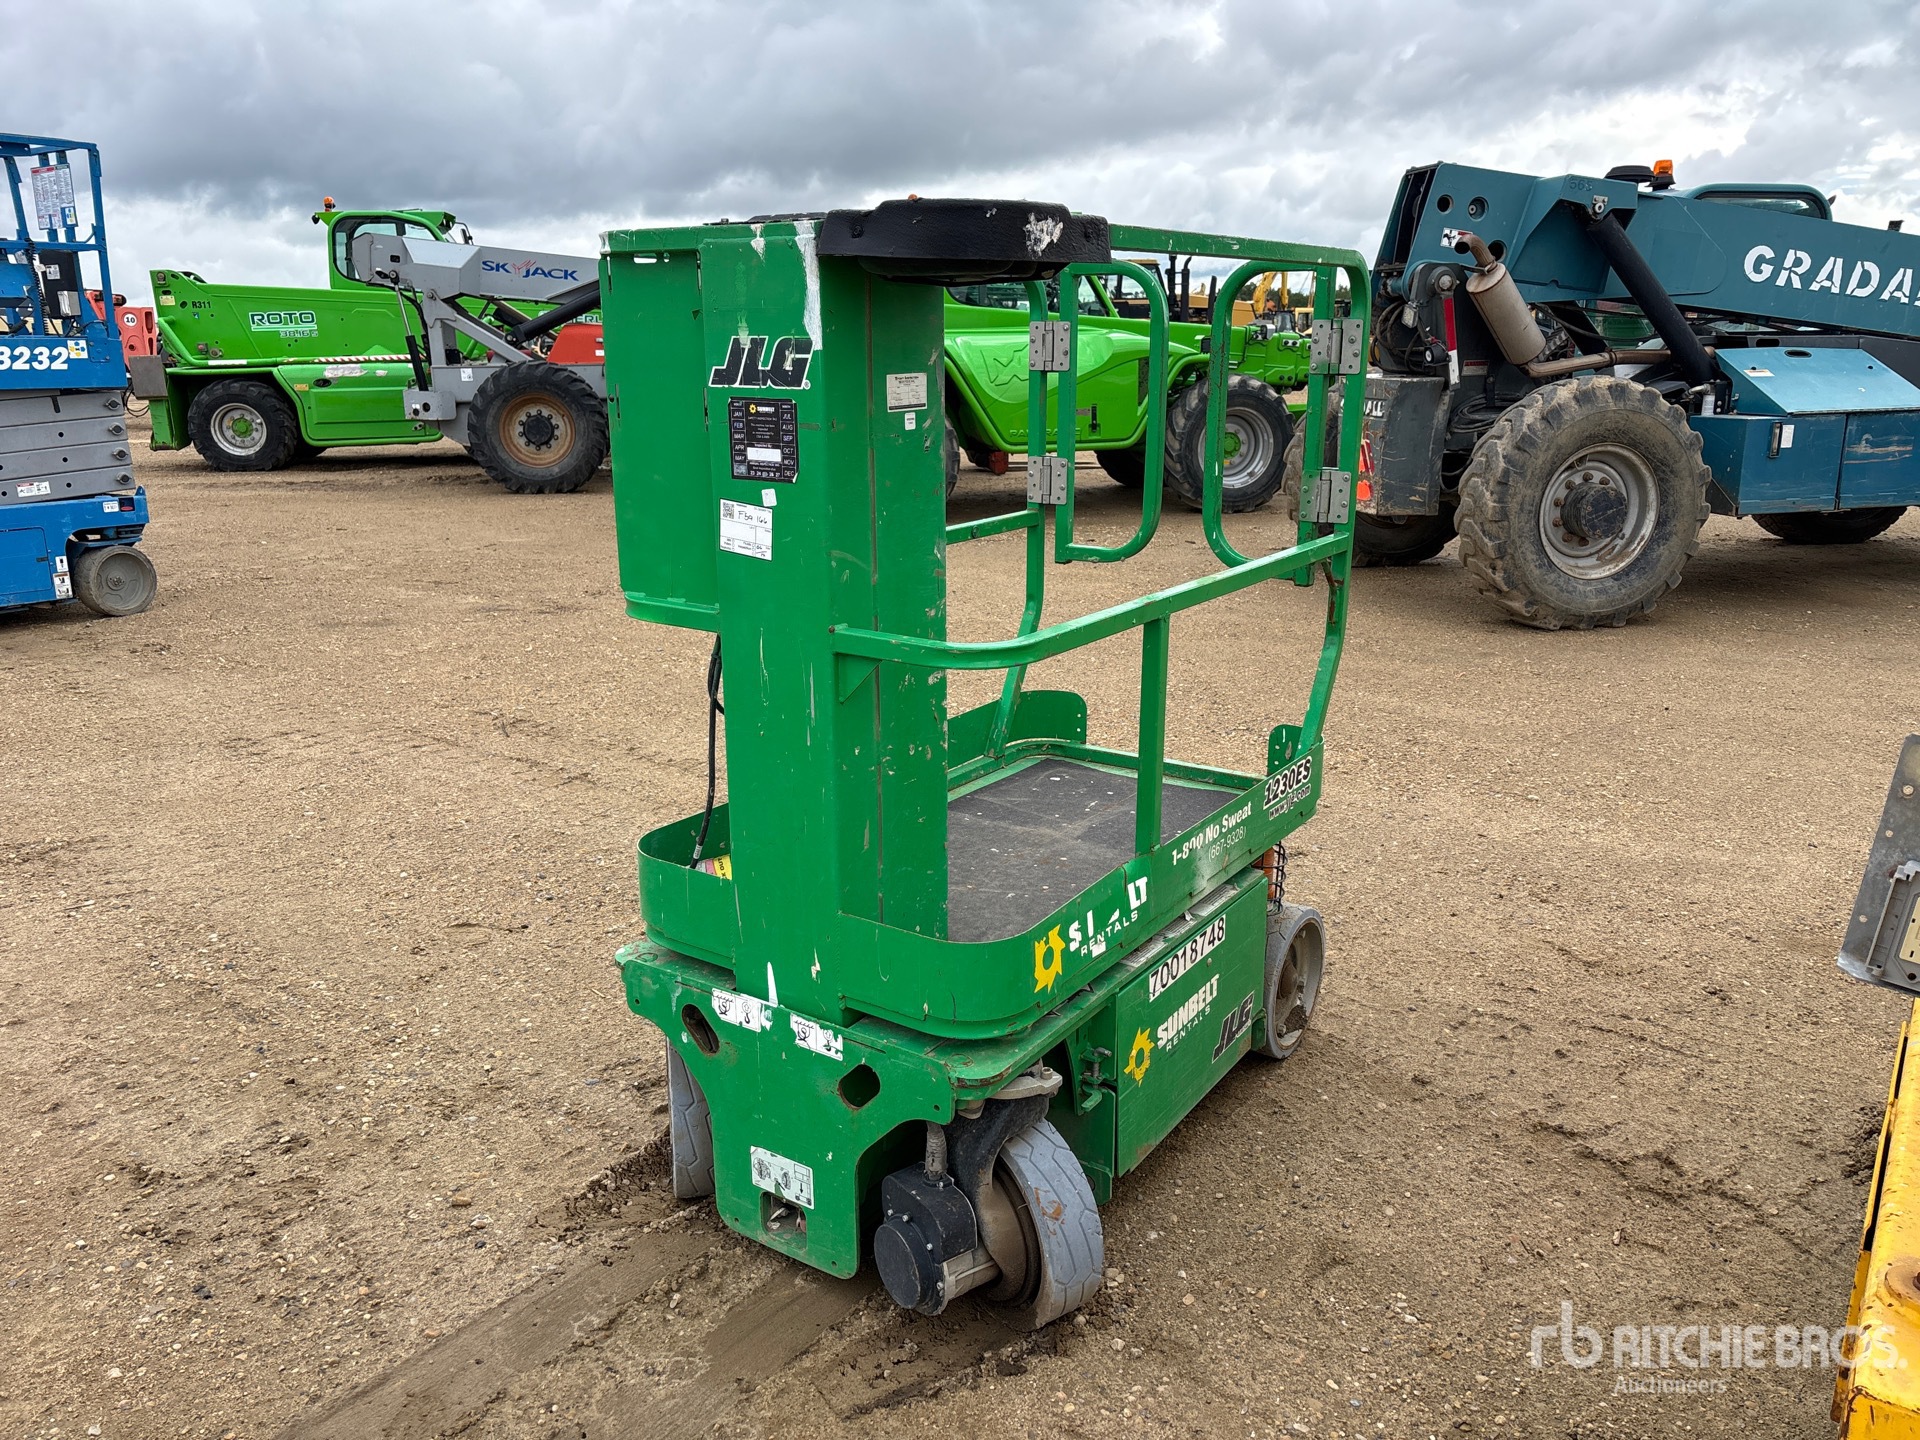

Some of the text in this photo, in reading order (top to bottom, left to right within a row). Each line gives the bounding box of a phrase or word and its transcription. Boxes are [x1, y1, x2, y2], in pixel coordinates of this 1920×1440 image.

[482, 259, 579, 282] SKYJACK
[125, 316, 136, 324] 10
[192, 301, 212, 309] R311
[249, 311, 316, 325] ROTO
[708, 335, 814, 390] JLG
[1263, 756, 1312, 810] 1230ES
[1172, 801, 1252, 866] 1-800 No Sweat
[1208, 826, 1246, 862] (667-9328)
[1080, 910, 1138, 957] RENTALS
[1150, 917, 1225, 998] 70018748
[1157, 973, 1220, 1050] SUNBELT
[1166, 1005, 1211, 1052] RENTALS
[1211, 989, 1255, 1064] JLG
